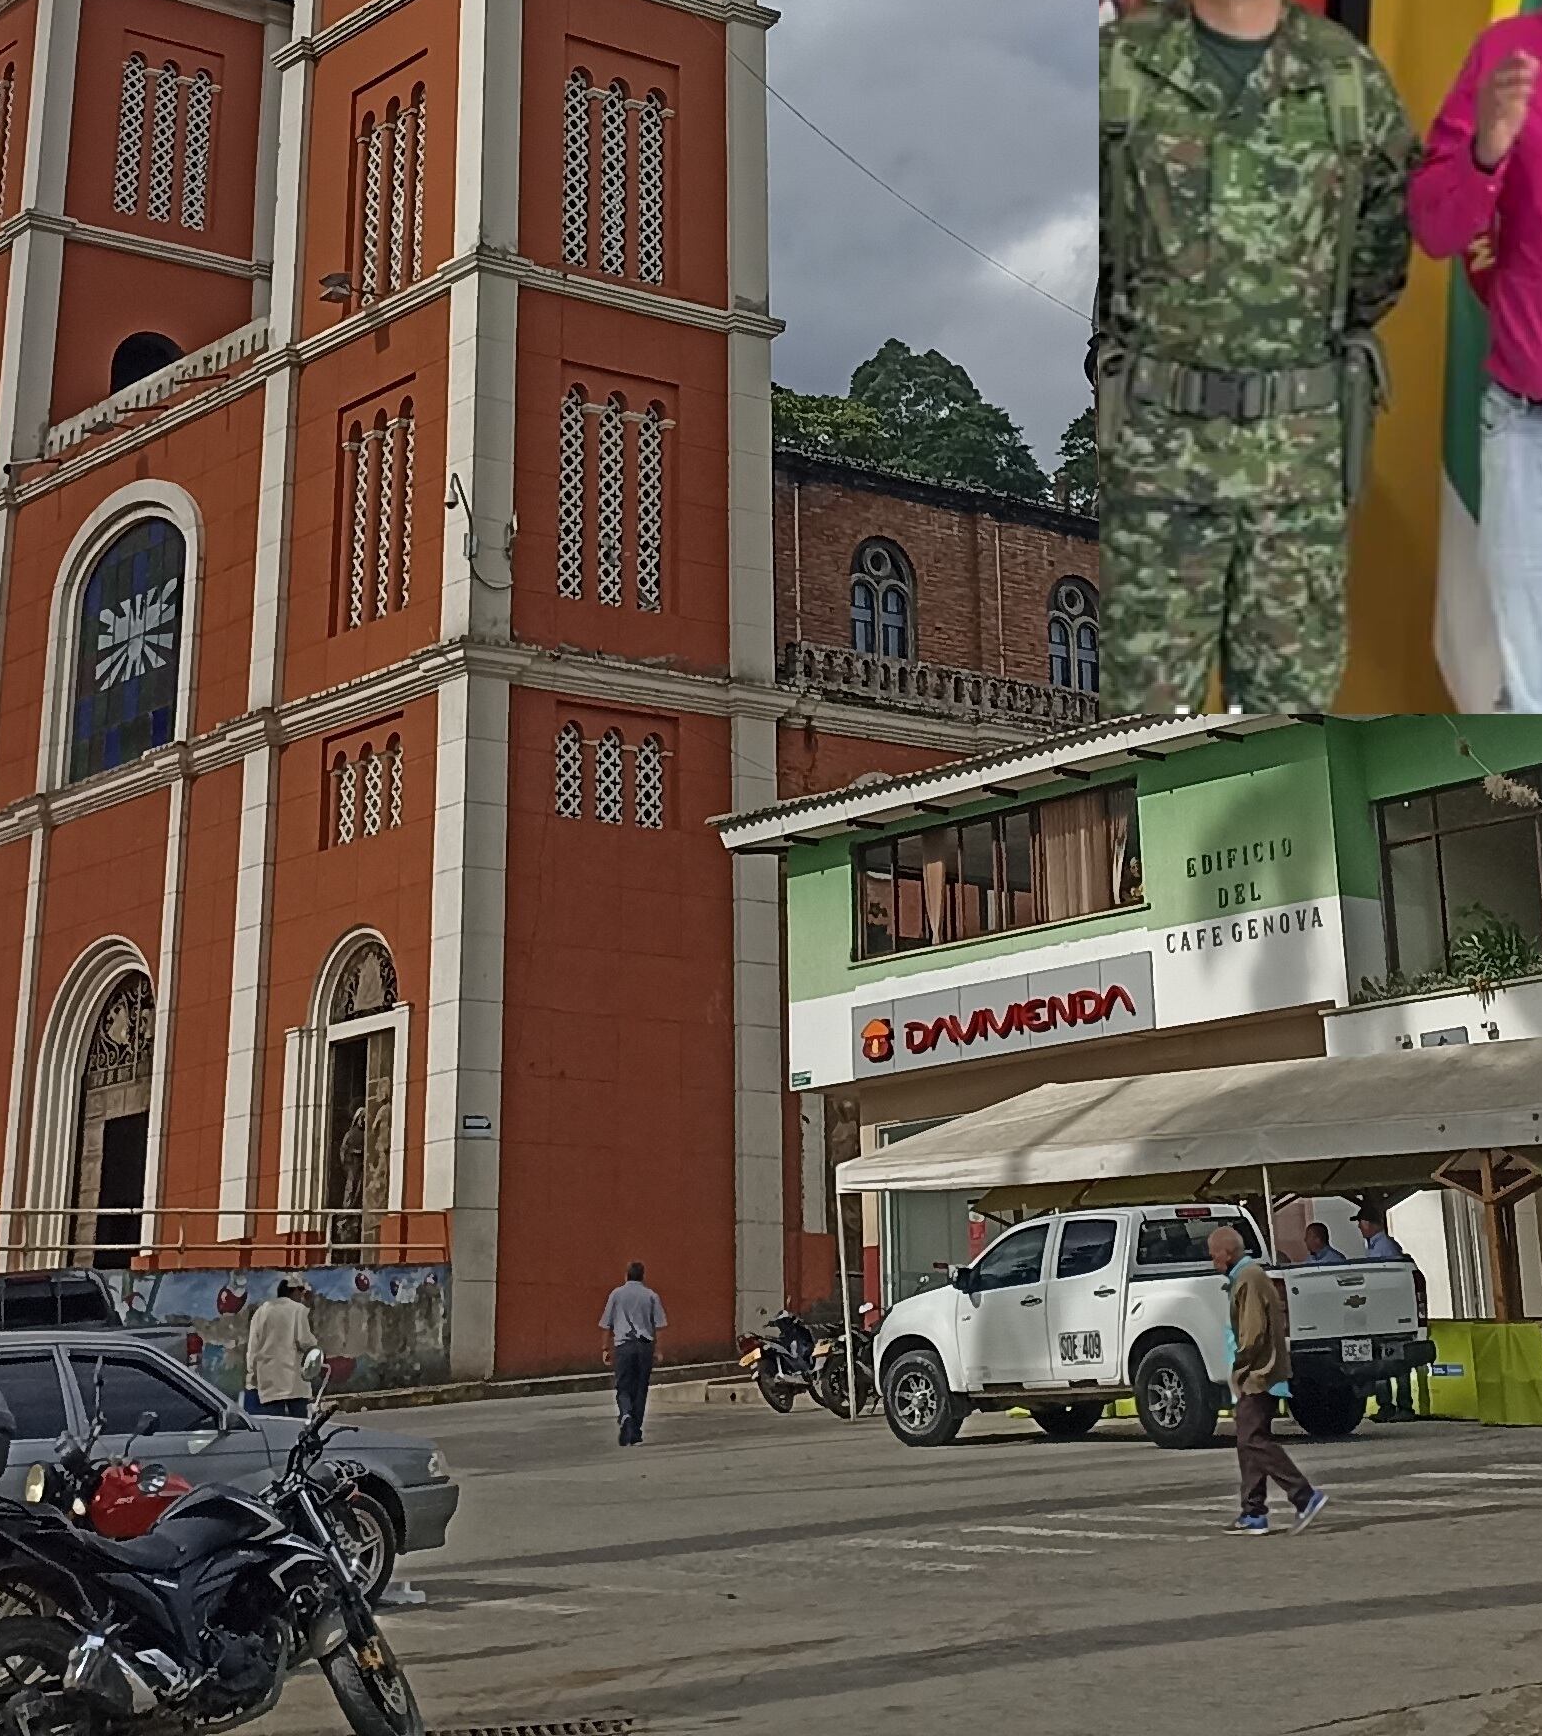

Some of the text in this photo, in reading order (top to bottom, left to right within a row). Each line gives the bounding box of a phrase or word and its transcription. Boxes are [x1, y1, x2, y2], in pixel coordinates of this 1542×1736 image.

[1186, 837, 1292, 879] EDIFICIO
[1218, 881, 1262, 909] DEL
[1166, 906, 1324, 954] CAFE GENOVA
[904, 985, 1136, 1054] DAVIVIENDA
[1083, 1333, 1101, 1359] 409
